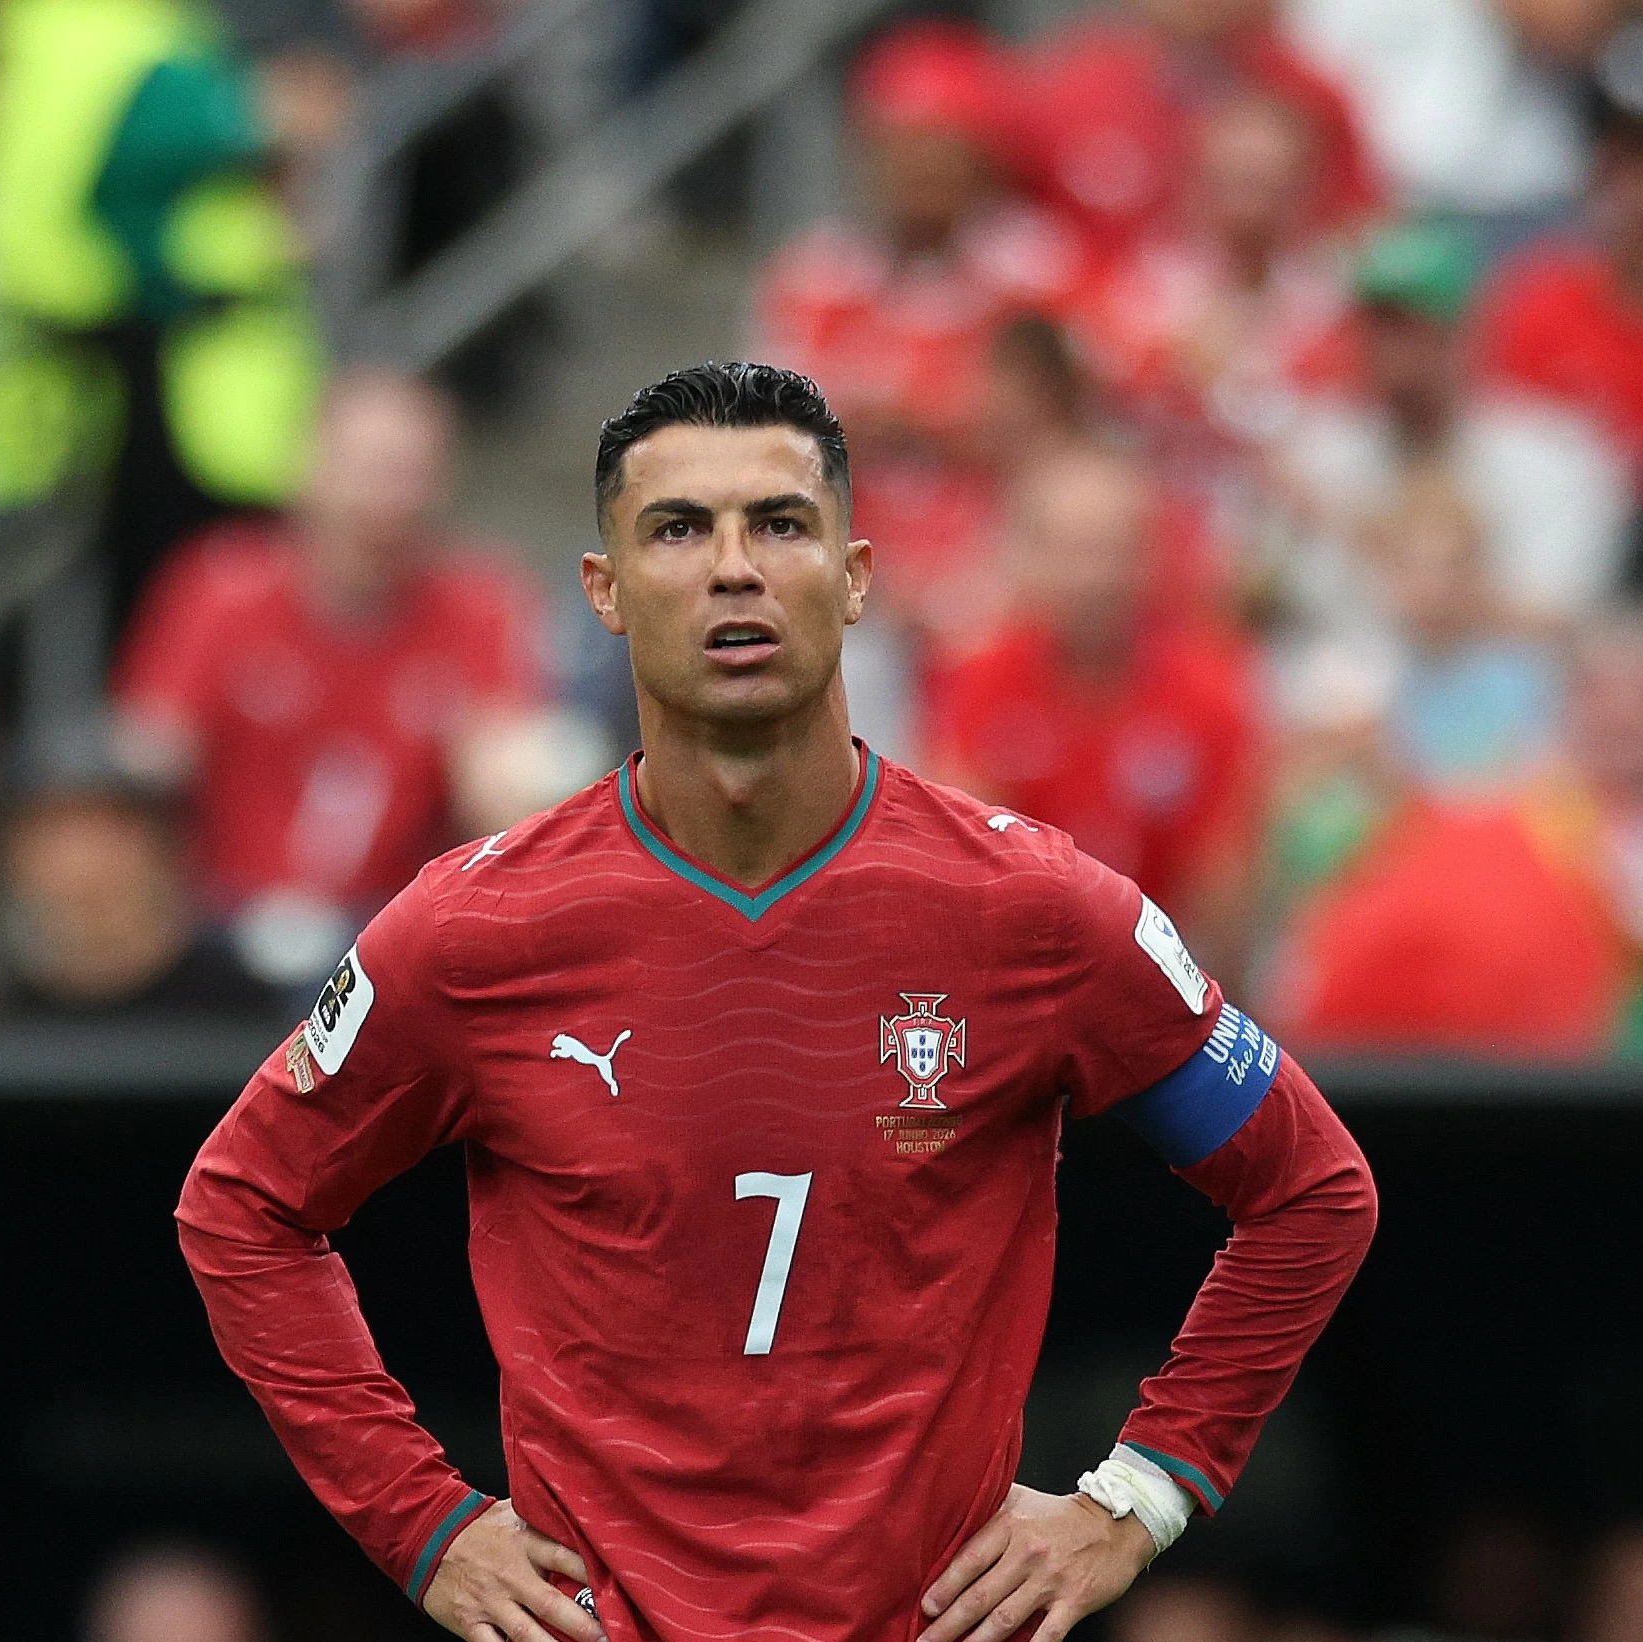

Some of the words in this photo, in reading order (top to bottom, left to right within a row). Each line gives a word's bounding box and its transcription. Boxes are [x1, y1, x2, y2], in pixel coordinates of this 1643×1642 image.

[1225, 1048, 1254, 1086] the
[883, 1129, 894, 1141] 17
[933, 1128, 956, 1140] 2026
[896, 1140, 946, 1154] HOUSTON
[735, 1171, 813, 1355] 7
